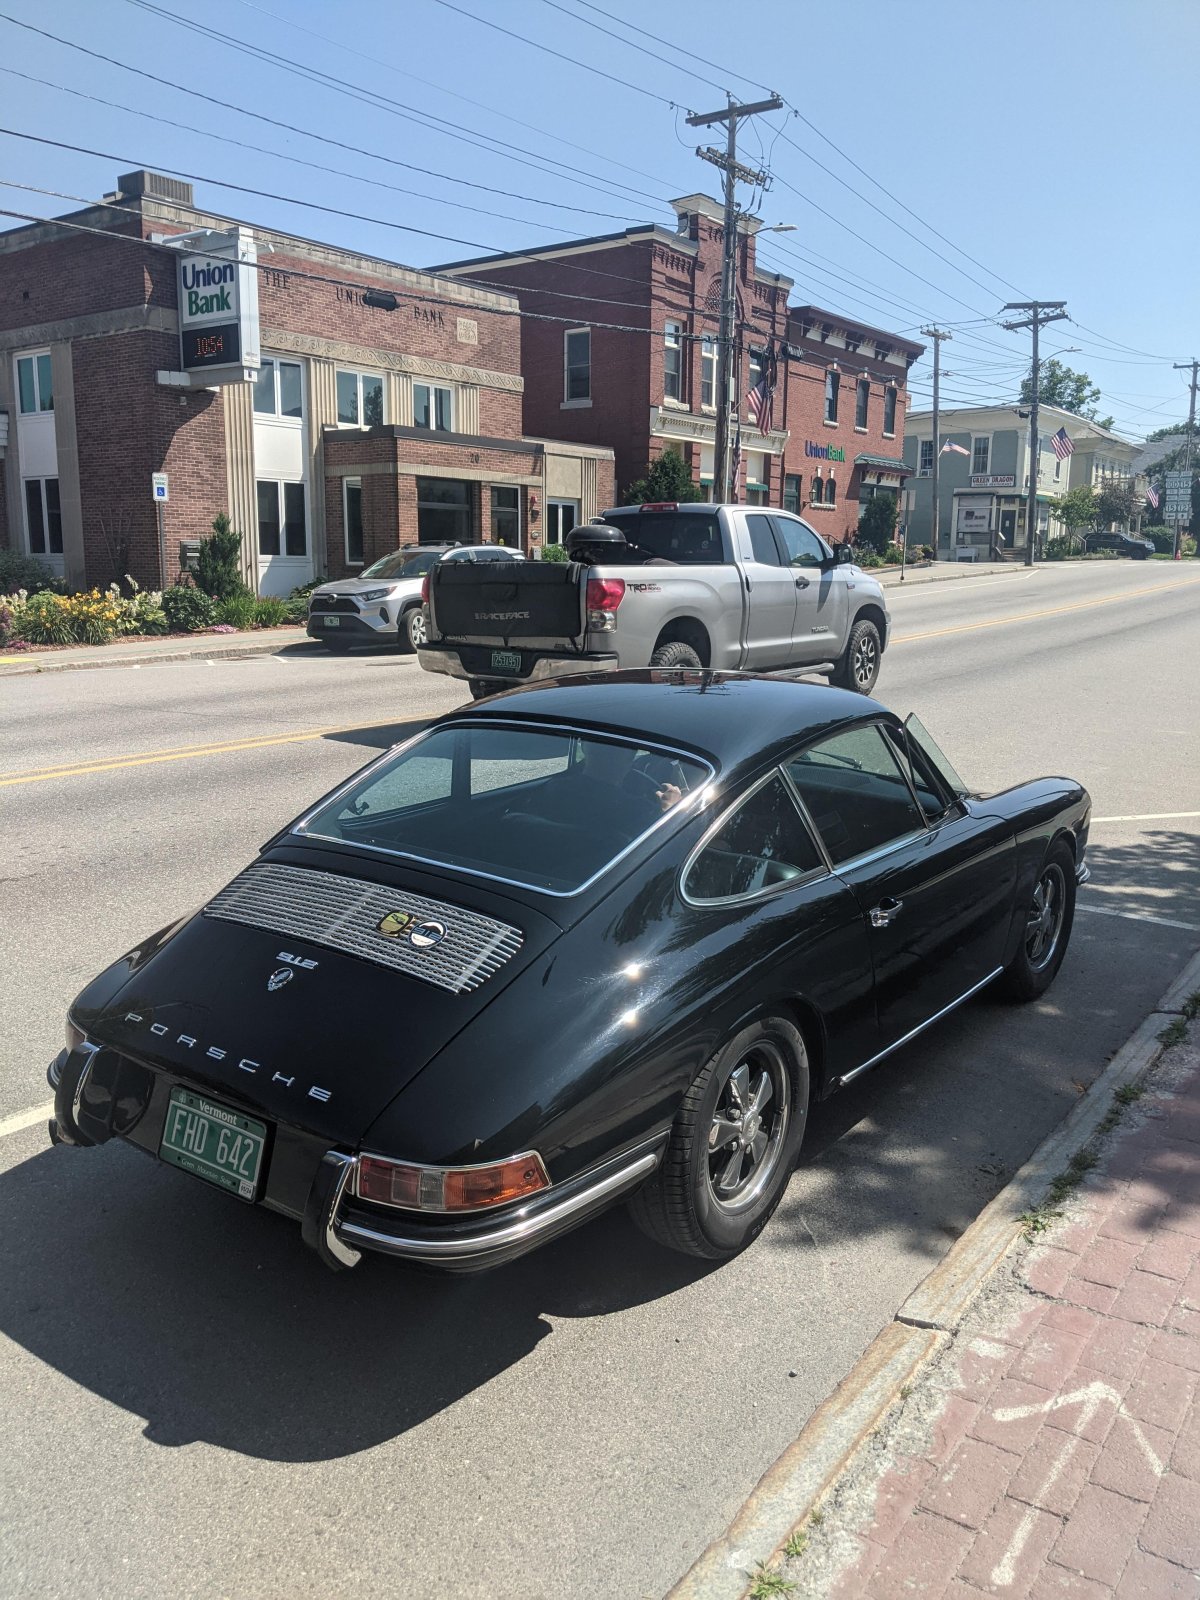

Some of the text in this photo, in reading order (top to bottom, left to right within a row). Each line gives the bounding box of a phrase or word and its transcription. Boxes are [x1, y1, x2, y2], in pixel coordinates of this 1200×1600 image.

[182, 262, 234, 290] Union
[187, 285, 231, 317] Bank
[263, 269, 291, 290] THE
[413, 305, 445, 326] BANK
[196, 335, 223, 355] 10:54
[991, 475, 1014, 483] DRAGON
[125, 1012, 333, 1103] PORSCHE
[199, 1100, 237, 1125] Vermont
[171, 1109, 254, 1176] FHD 642
